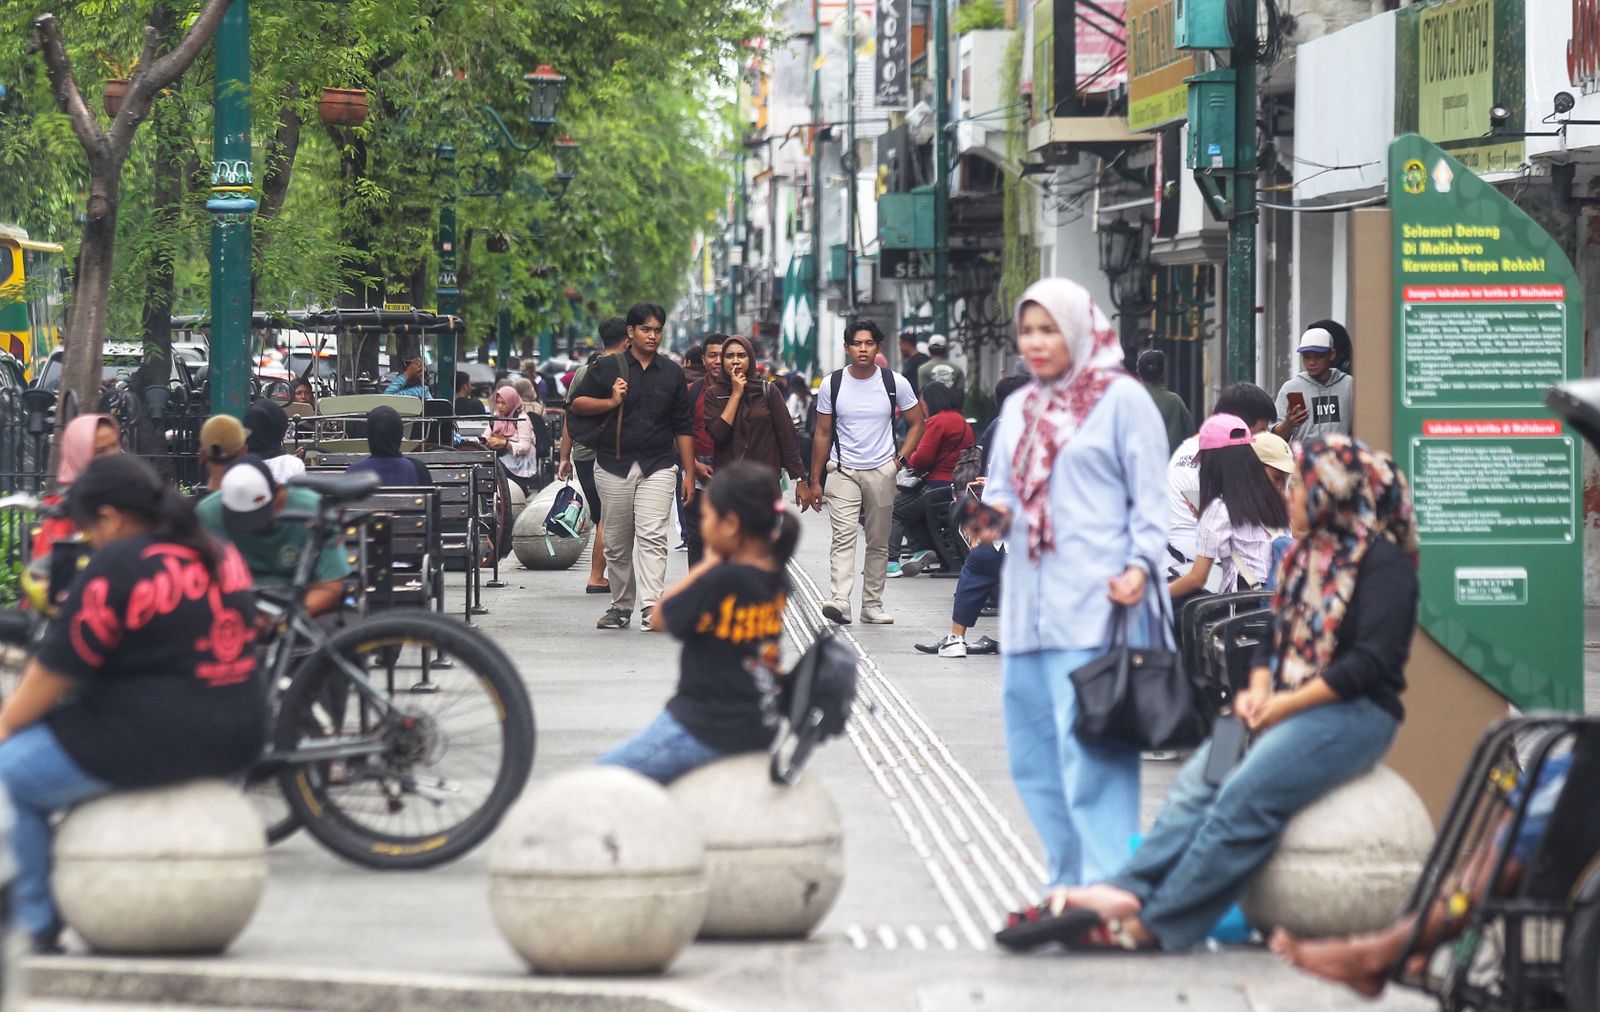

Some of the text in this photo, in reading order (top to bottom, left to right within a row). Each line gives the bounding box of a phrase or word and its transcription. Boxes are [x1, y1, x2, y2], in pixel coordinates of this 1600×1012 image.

[1403, 224, 1500, 240] Selamat Datang
[1403, 241, 1484, 255] Di Malioboro
[1403, 257, 1545, 275] Kawasan Tanpa Rokok!
[1316, 403, 1336, 416] NYC
